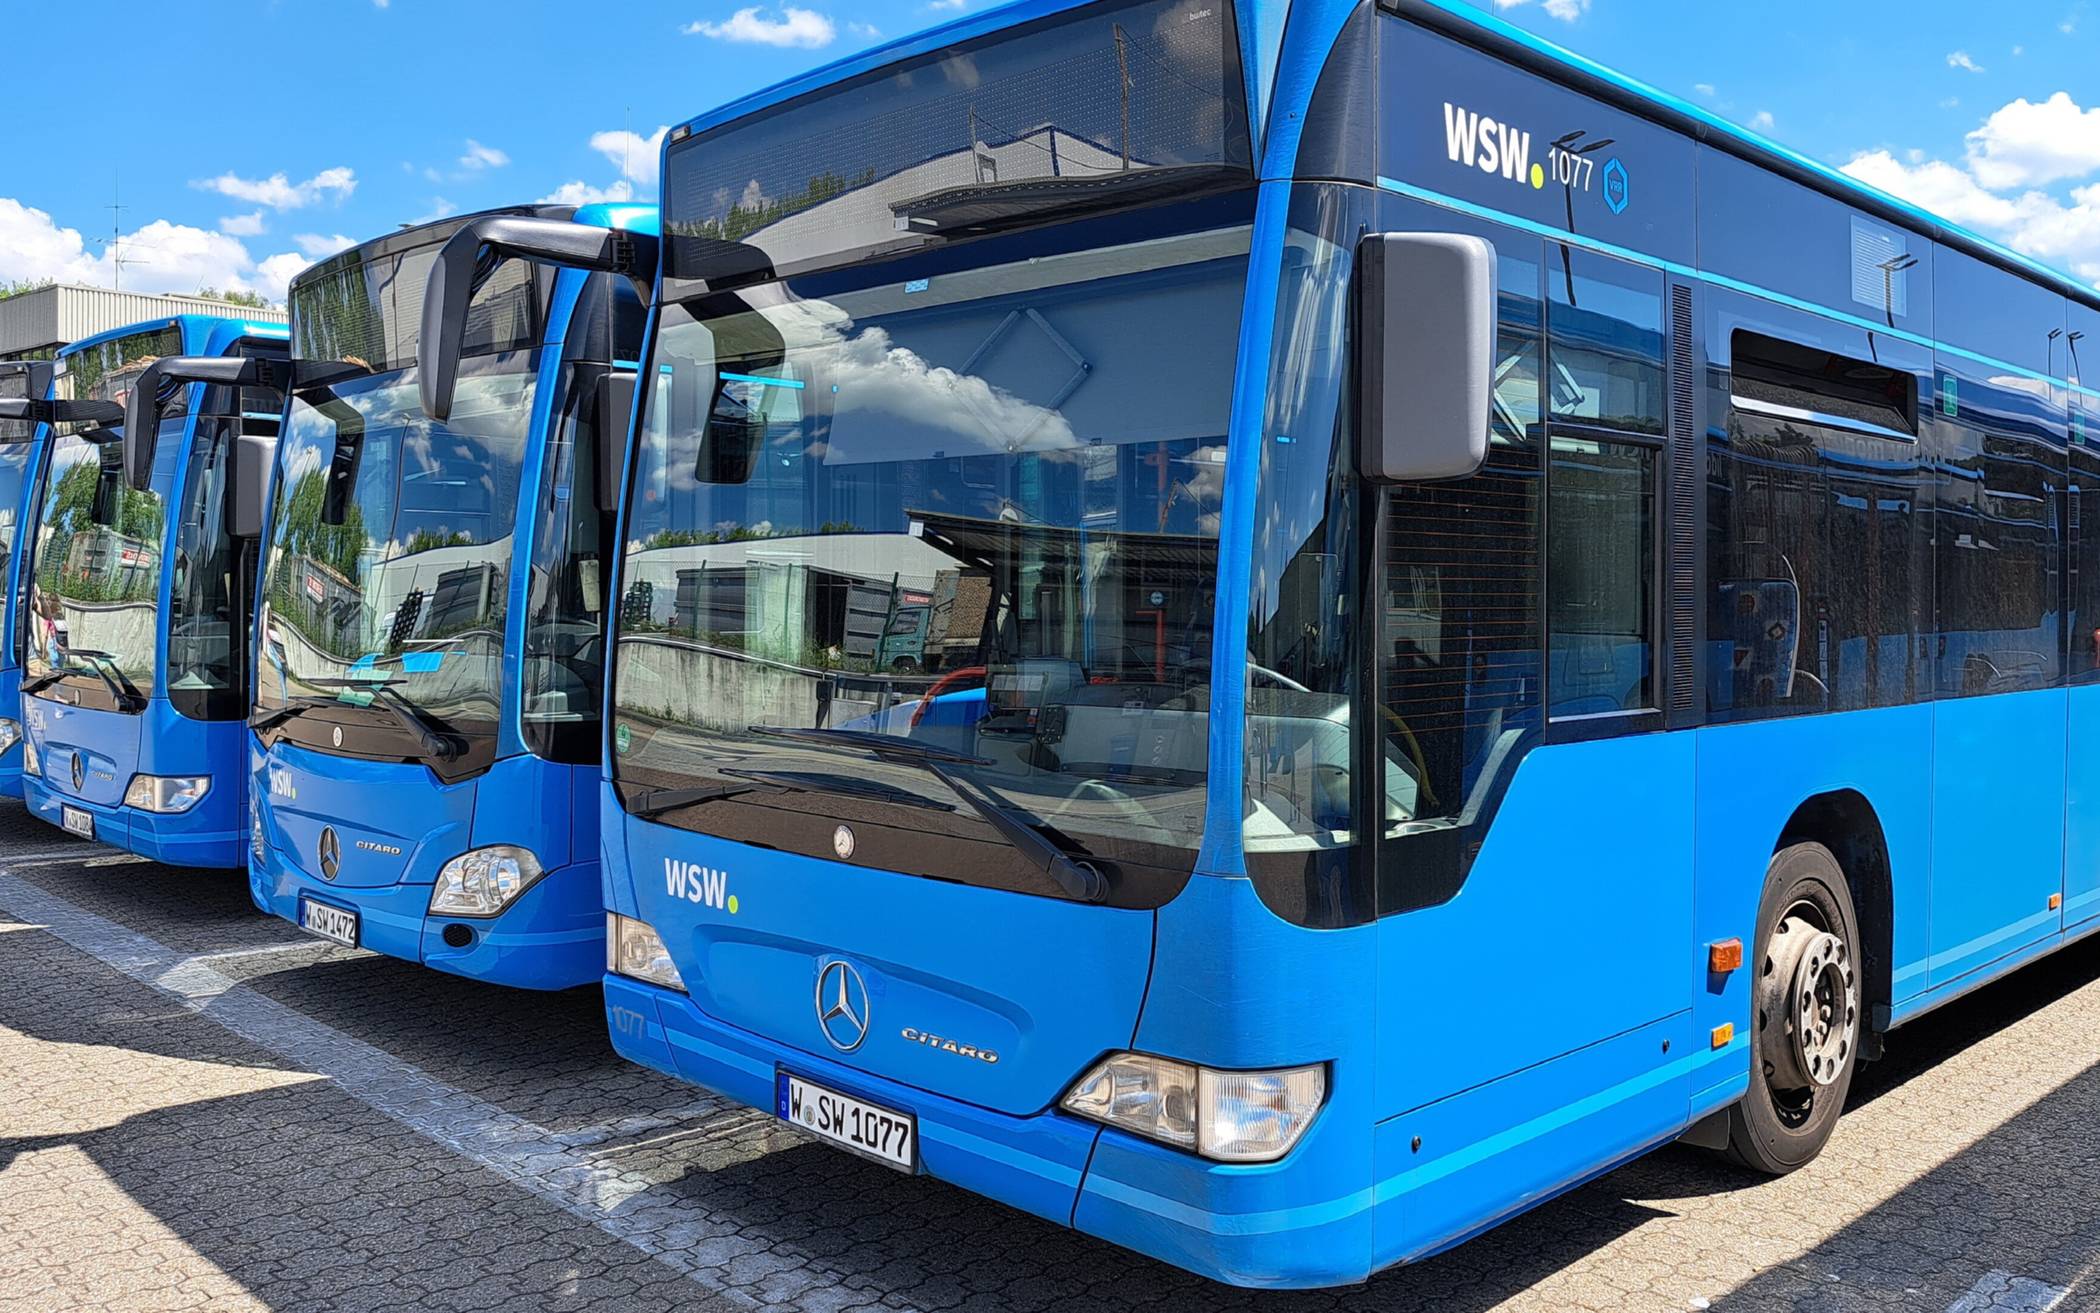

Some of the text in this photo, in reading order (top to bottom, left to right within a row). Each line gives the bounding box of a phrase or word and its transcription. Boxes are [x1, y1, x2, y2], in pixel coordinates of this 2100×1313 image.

[1549, 147, 1593, 192] 1077
[1608, 178, 1623, 193] VRR
[356, 840, 402, 855] CITARO
[317, 907, 328, 934] SW
[330, 912, 355, 940] 1472
[612, 1005, 645, 1040] 1077
[901, 1027, 999, 1063] CITARO
[791, 1083, 909, 1159] W SW 1077
